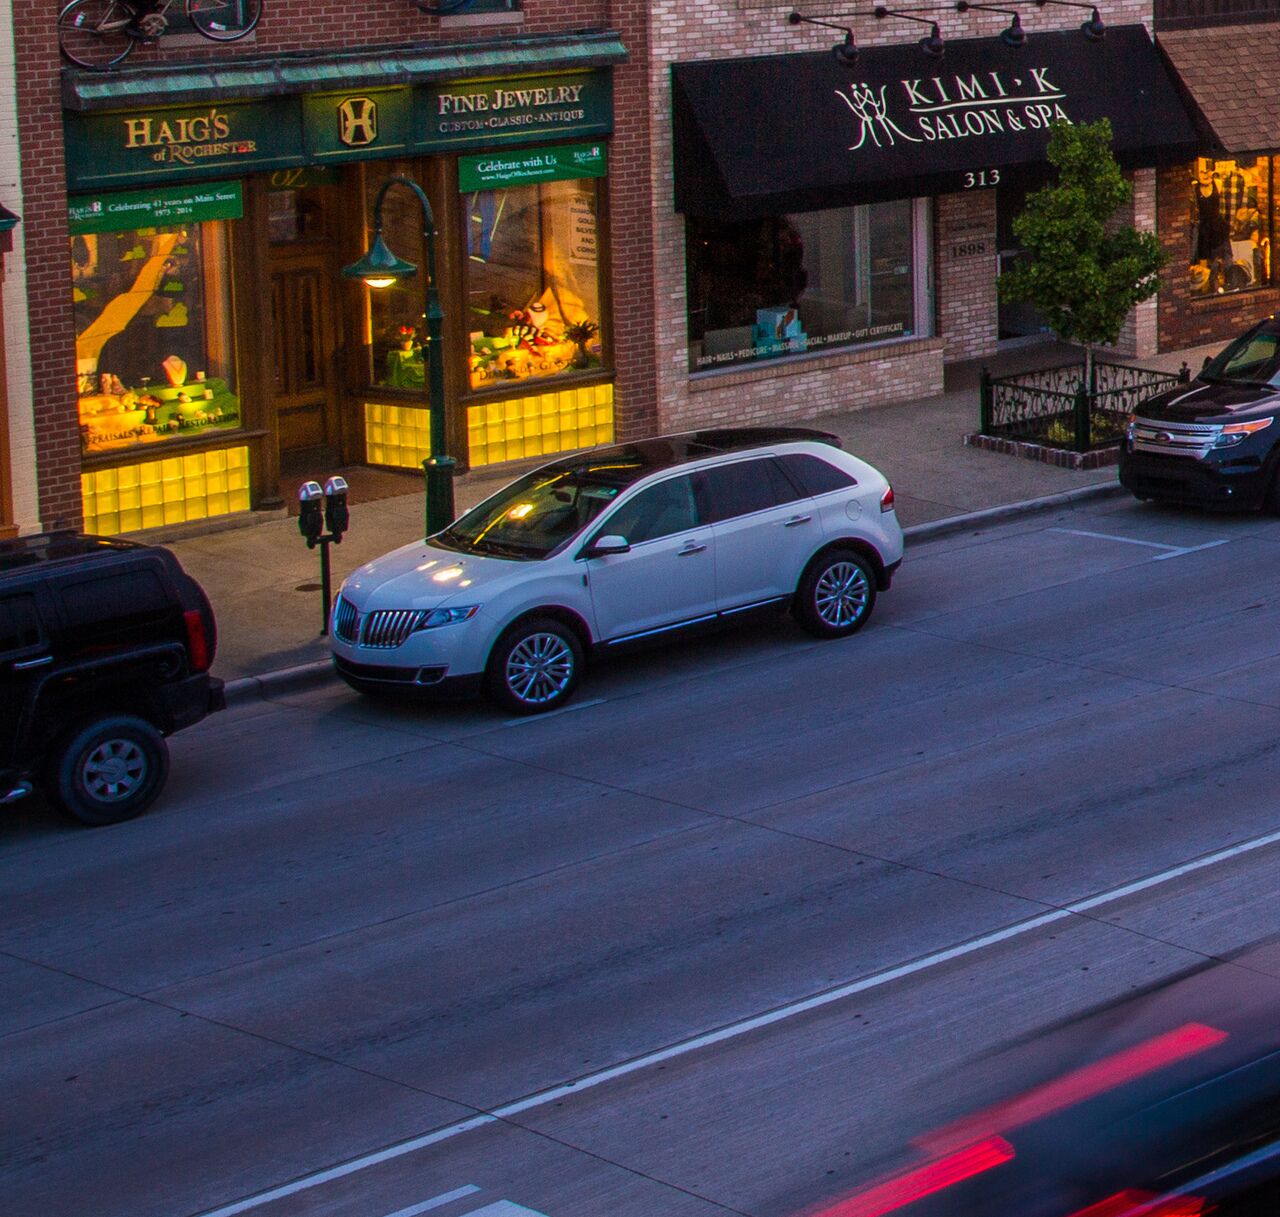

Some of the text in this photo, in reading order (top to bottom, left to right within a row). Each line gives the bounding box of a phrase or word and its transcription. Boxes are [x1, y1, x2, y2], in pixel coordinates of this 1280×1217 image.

[902, 67, 1061, 106] KIMI K
[439, 85, 584, 115] FINE JEWELRY
[124, 109, 230, 148] HAIG'S
[919, 103, 1074, 141] SALON & SPA
[153, 141, 257, 164] of ROCHESTER
[478, 155, 557, 173] Celebrate with Us
[964, 169, 1000, 188] 313
[108, 201, 152, 212] Celebrating
[153, 199, 161, 207] 41
[163, 199, 182, 208] years
[195, 193, 214, 203] Main
[215, 192, 236, 201] Street
[953, 241, 985, 257] 1898
[697, 356, 712, 366] HAIR
[716, 352, 734, 362] NAILS
[738, 345, 768, 358] PEDICURE
[828, 330, 852, 342] MAKEUP
[855, 327, 868, 338] GIFT
[869, 322, 903, 336] CERTIFICATE
